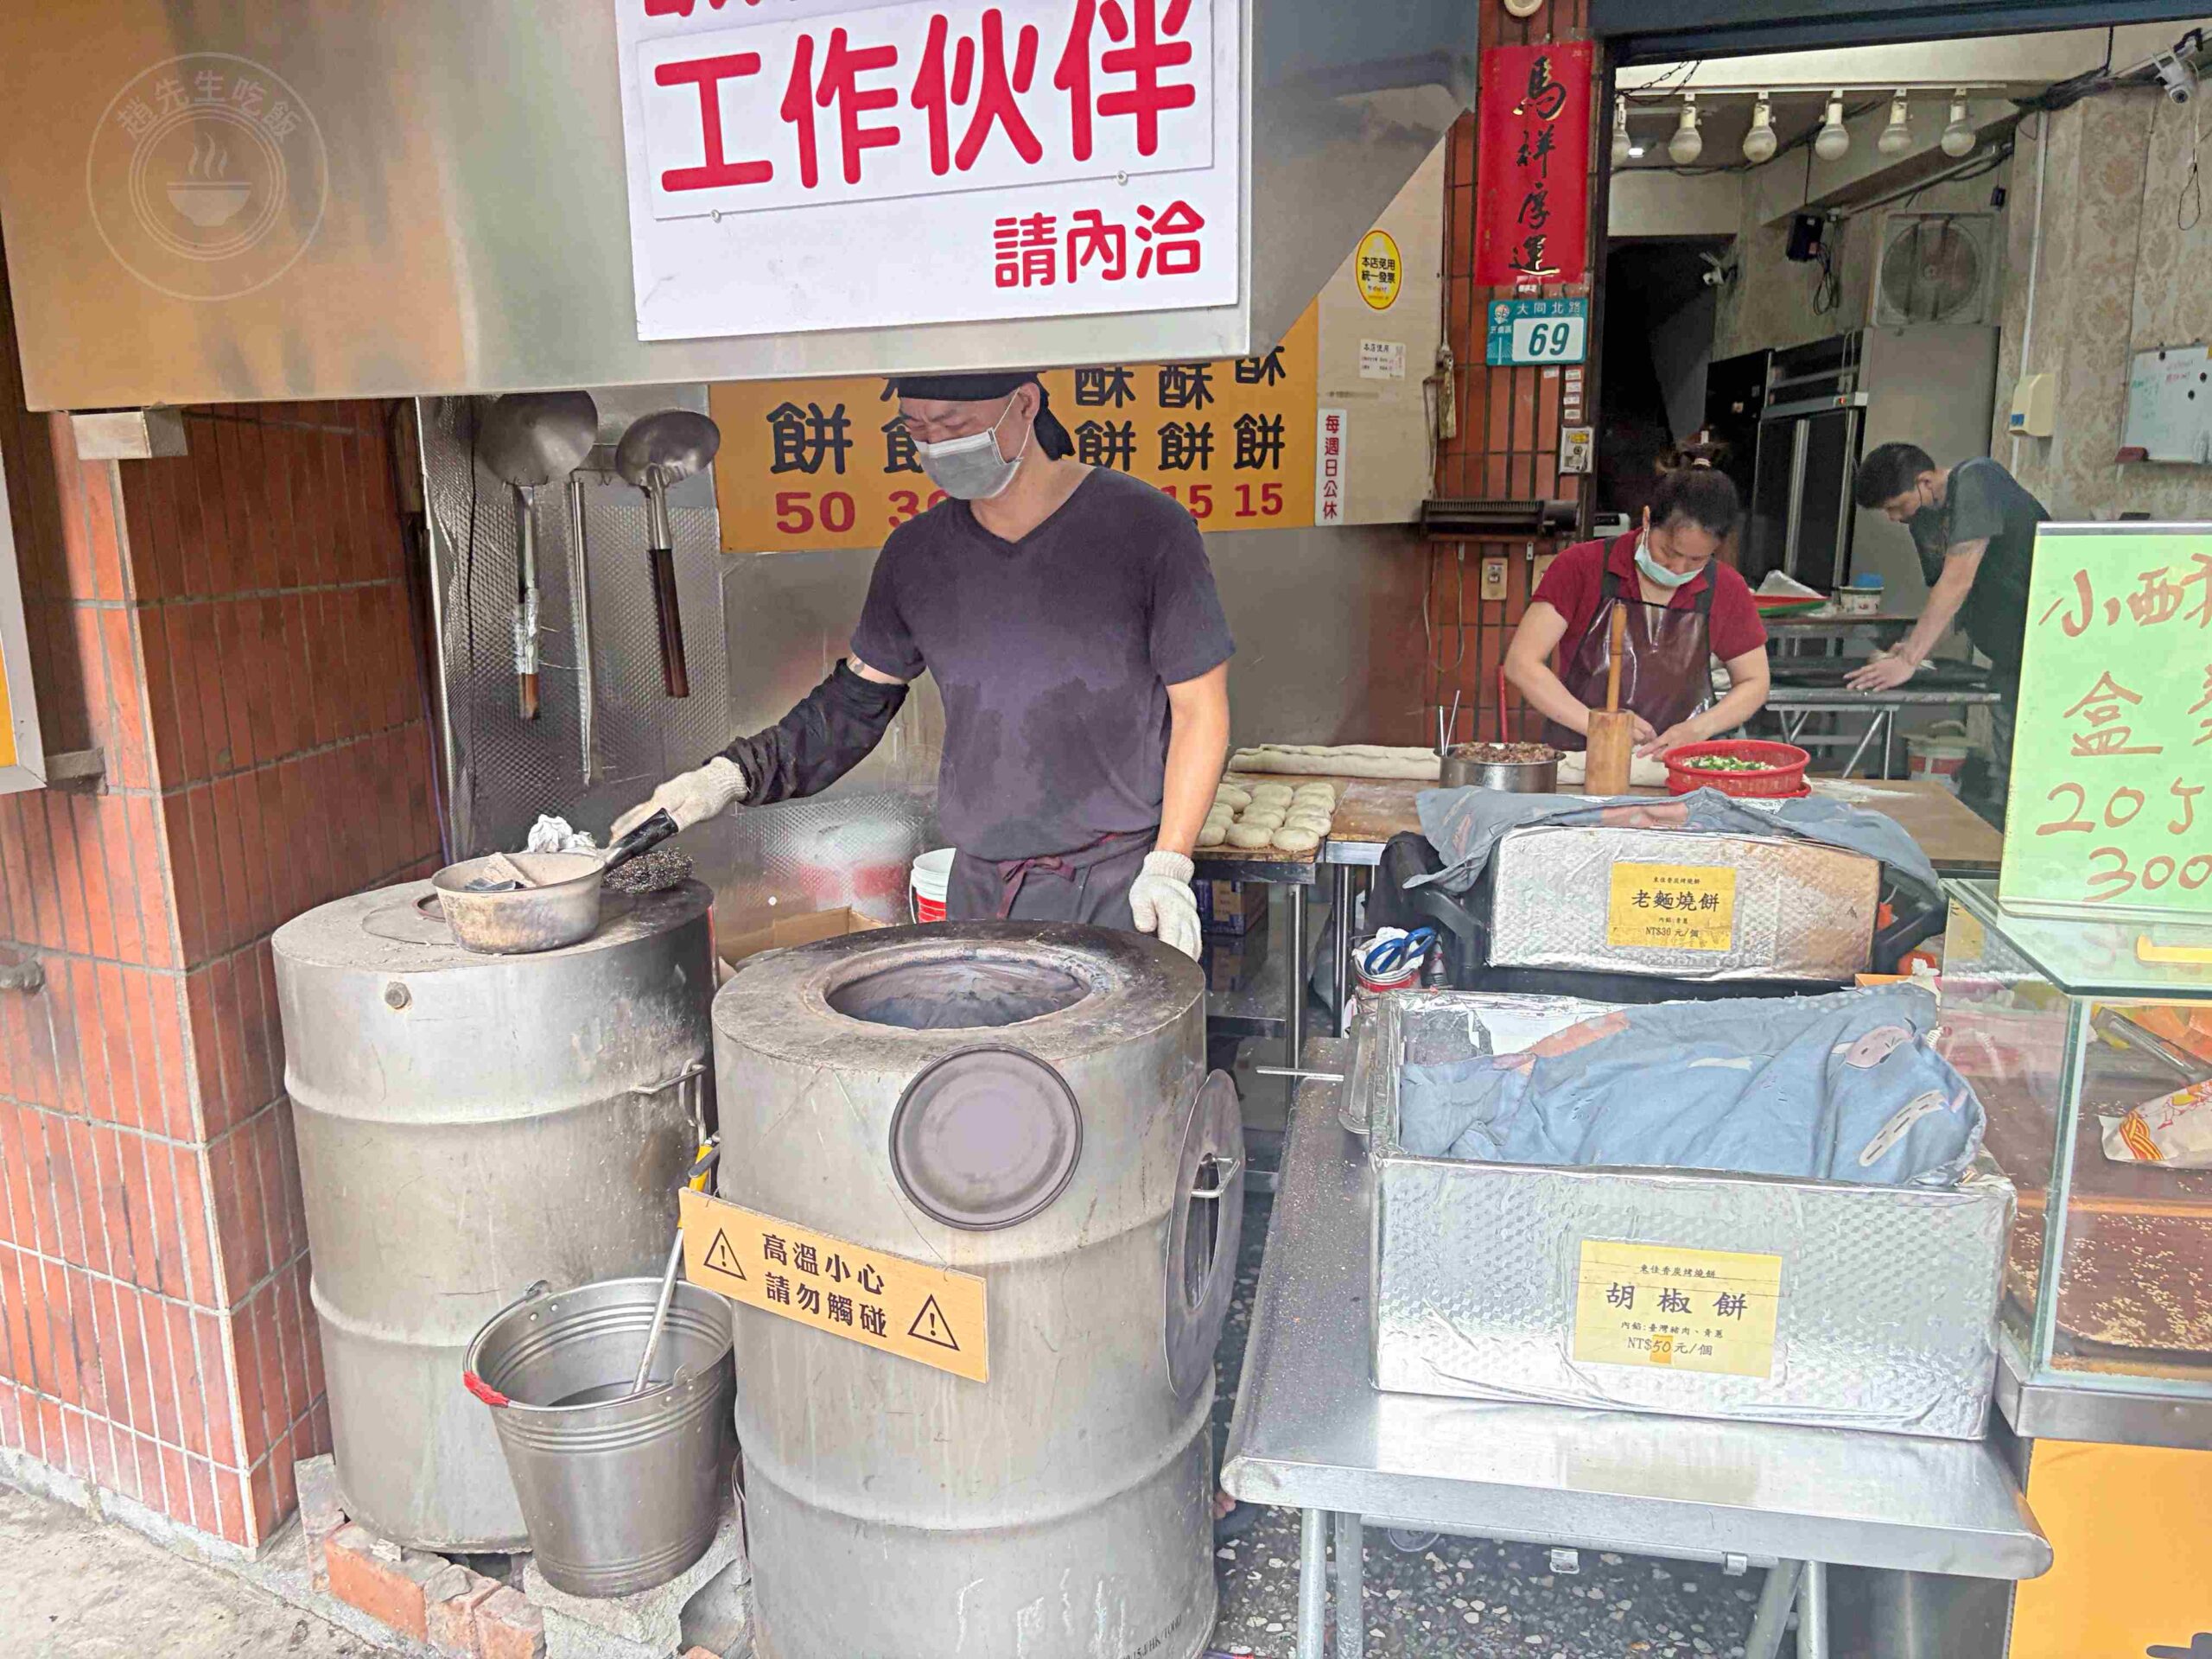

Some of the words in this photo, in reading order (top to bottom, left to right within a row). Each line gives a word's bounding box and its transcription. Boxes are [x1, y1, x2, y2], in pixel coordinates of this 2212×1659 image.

[654, 0, 1196, 191] 工作伙伴
[994, 200, 1205, 288] 請內洽
[1362, 257, 1395, 270] 本店免用
[1362, 270, 1395, 283] 統一發票
[1516, 302, 1580, 315] 大同北路
[1529, 322, 1570, 356] 69
[1323, 415, 1340, 519] 每週日公休
[776, 491, 855, 534] 50
[1235, 483, 1283, 517] 15
[762, 1233, 885, 1295] 高溫小心
[765, 1271, 887, 1338] 請勿觸碰
[1605, 1282, 1748, 1320] 胡椒餅
